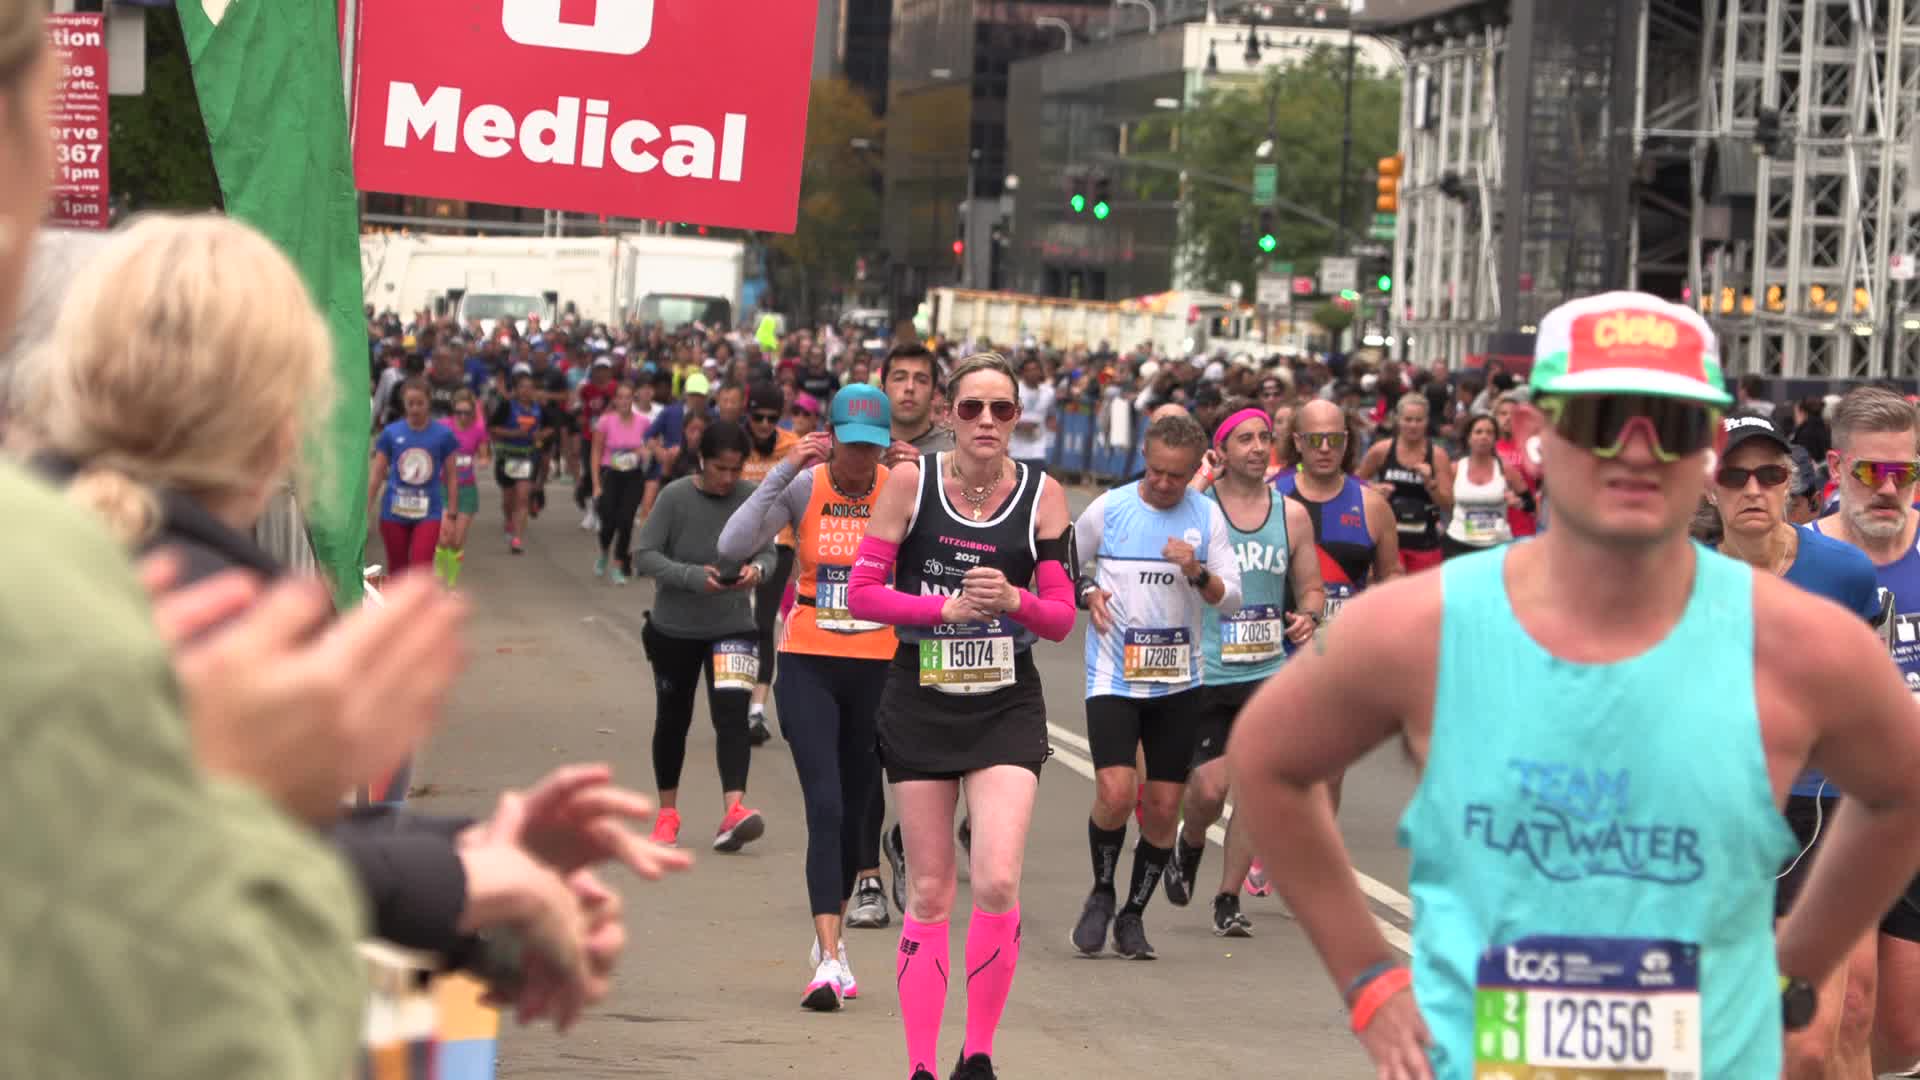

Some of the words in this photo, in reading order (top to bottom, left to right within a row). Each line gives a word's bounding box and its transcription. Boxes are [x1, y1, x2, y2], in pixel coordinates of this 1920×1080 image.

[52, 30, 100, 46] tion
[51, 126, 98, 140] erve
[384, 80, 747, 182] Medical
[63, 167, 99, 180] 1pm
[821, 503, 871, 518] ANICK
[820, 519, 872, 530] EVERY
[818, 532, 865, 543] MOTH
[939, 535, 997, 553] FITZGIBBON
[818, 545, 856, 556] COU
[954, 551, 980, 564] 2021
[1233, 541, 1286, 575] HRIS
[826, 563, 845, 580] tcs
[1139, 571, 1174, 585] TITO
[1134, 631, 1151, 644] tcs
[1241, 623, 1271, 642] 20215
[949, 640, 994, 667] 15074
[1144, 647, 1178, 667] 17286
[1507, 758, 1632, 822] TEAM
[1464, 803, 1705, 885] FLATWATER
[1505, 945, 1560, 982] tcs
[1543, 997, 1654, 1062] 12656
